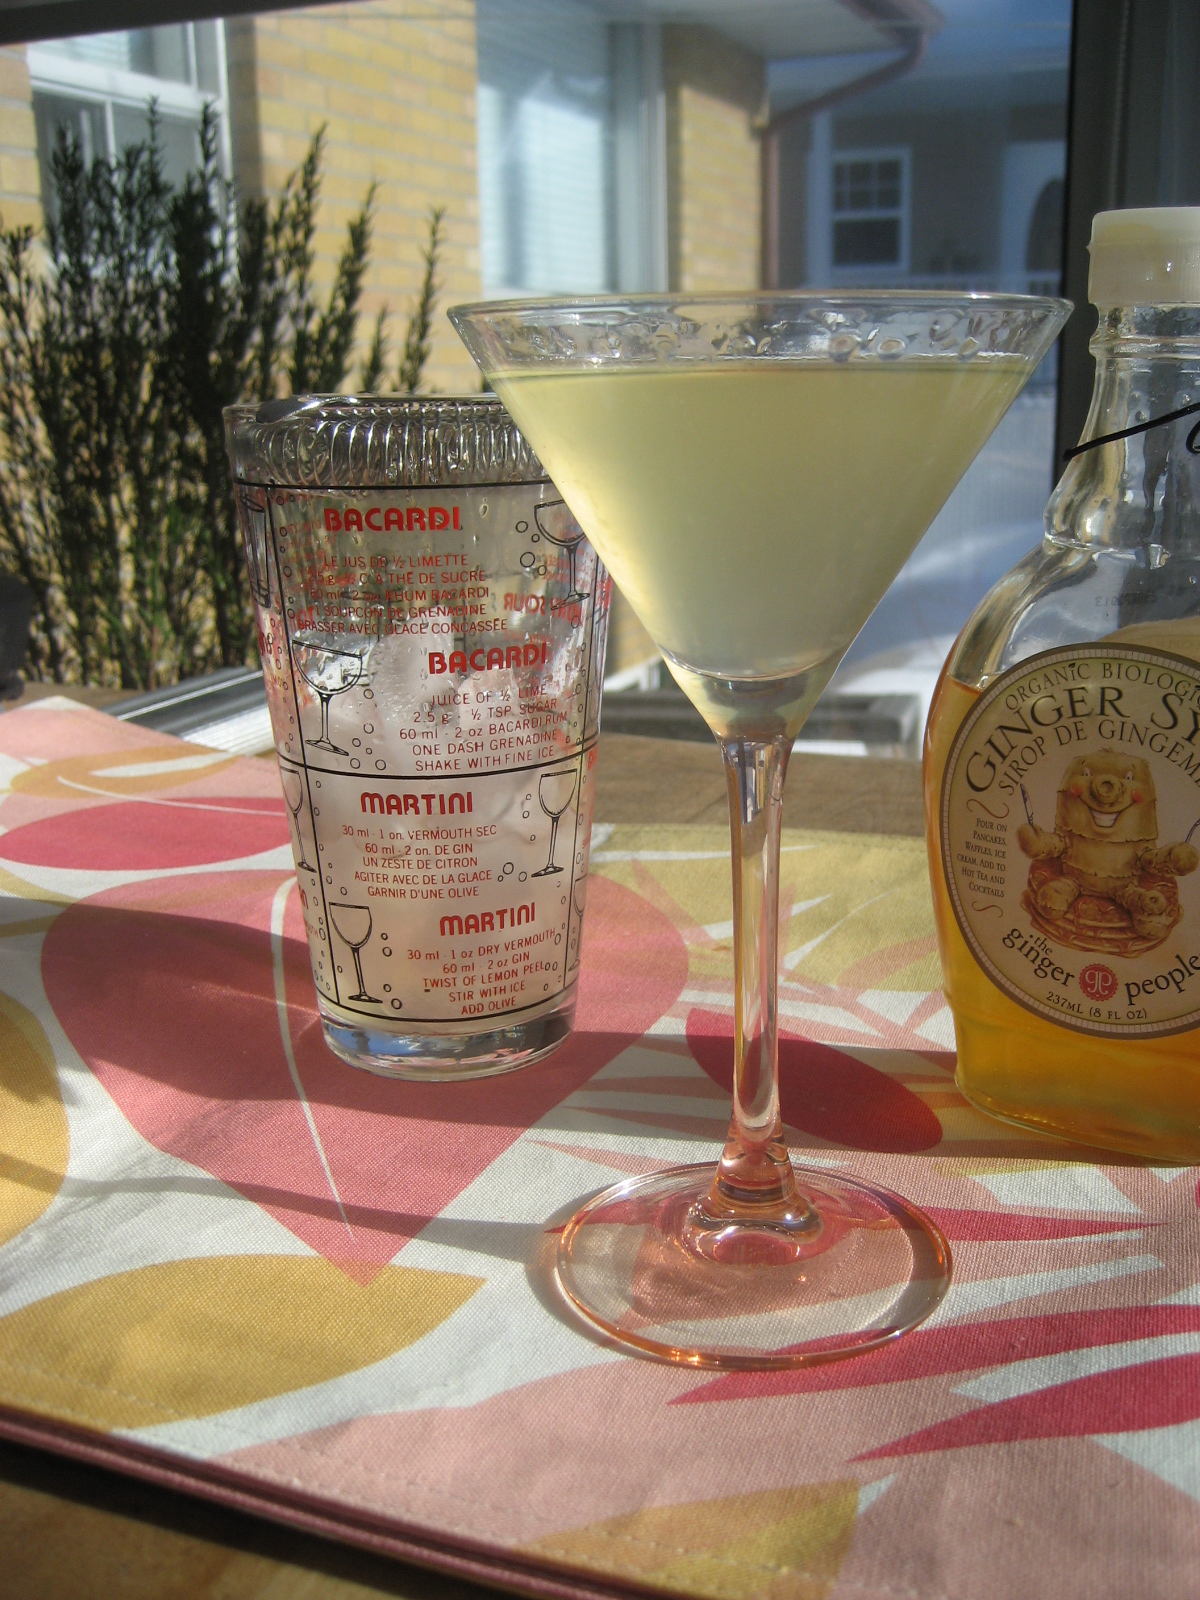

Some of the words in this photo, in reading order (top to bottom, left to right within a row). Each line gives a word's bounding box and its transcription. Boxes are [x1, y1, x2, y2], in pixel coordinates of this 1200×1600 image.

[324, 506, 461, 532] BACARDI
[323, 556, 337, 568] LE
[343, 556, 366, 568] JUS
[370, 556, 387, 568] DE
[409, 554, 469, 568] LIMETTE
[419, 572, 437, 584] DE
[440, 570, 486, 584] SUCRE
[310, 589, 323, 600] 60
[326, 590, 340, 600] ml
[352, 590, 359, 601] 2
[385, 590, 427, 602] RHUM
[431, 587, 489, 602] BACARDI
[387, 607, 405, 619] DE
[409, 604, 487, 619] GRENADINE
[297, 620, 345, 633] BRASSER
[349, 623, 380, 635] AVEC
[384, 623, 427, 635] GLACE
[428, 643, 546, 675] BACARDI
[430, 693, 470, 707] JUICE
[476, 691, 492, 704] OF
[518, 684, 547, 699] LIME
[519, 699, 557, 715] SUGAR
[400, 728, 417, 740] 60
[422, 728, 438, 740] ml
[455, 727, 462, 738] 2
[468, 727, 482, 737] oz
[489, 717, 542, 735] BACARDI
[545, 711, 568, 726] RUM
[412, 743, 441, 756] ONE
[447, 740, 484, 755] DASH
[489, 730, 557, 750] GRENADINE
[965, 686, 1130, 793] GINGER
[416, 759, 461, 772] SHAKE
[468, 754, 500, 769] WITH
[505, 750, 533, 765] FINE
[538, 745, 555, 759] ICE
[998, 736, 1046, 796] SIROP
[1054, 720, 1088, 747] DE
[1098, 719, 1200, 788] GINGEM
[360, 791, 473, 815] MARTINI
[342, 825, 354, 836] 30
[357, 828, 369, 838] ml
[380, 829, 384, 839] 1
[408, 827, 472, 840] VERMOUTH
[476, 824, 497, 837] SEC
[365, 843, 378, 854] 60
[382, 845, 395, 855] ml
[404, 845, 412, 856] 2
[435, 845, 449, 855] DE
[453, 843, 473, 855] GIN
[363, 856, 378, 867] UN
[381, 857, 413, 870] ZESTE
[417, 859, 432, 870] DE
[435, 856, 478, 869] CITRON
[354, 870, 389, 884] AGITER
[392, 874, 419, 885] AVEC
[423, 874, 437, 885] DE
[441, 872, 455, 884] LA
[458, 870, 492, 883] GLACE
[990, 875, 1005, 885] AND
[367, 886, 407, 899] GARNIR
[410, 888, 444, 899] D'UNE
[448, 886, 479, 898] OLIVE
[439, 902, 535, 936] MARTINI
[408, 950, 422, 960] 30
[425, 950, 440, 960] ml
[451, 949, 456, 960] 1
[461, 950, 473, 959] oz
[478, 944, 501, 957] DRY
[504, 927, 556, 952] VERMOUTH
[1034, 936, 1053, 956] the
[443, 963, 457, 974] 60
[461, 962, 475, 972] ml
[487, 960, 494, 970] 2
[497, 958, 509, 968] oz
[512, 951, 530, 964] GIN
[1002, 928, 1075, 988] ginger
[1125, 953, 1200, 1006] people
[423, 977, 457, 988] TWIST
[463, 976, 476, 987] OF
[481, 968, 519, 985] LEMON
[523, 960, 545, 975] PEEL
[449, 990, 474, 1002] STIR
[480, 985, 506, 998] WITH
[510, 980, 526, 993] ICE
[461, 1003, 484, 1015] ADD
[488, 996, 517, 1011] OLIVE
[1107, 1011, 1121, 1020] FL
